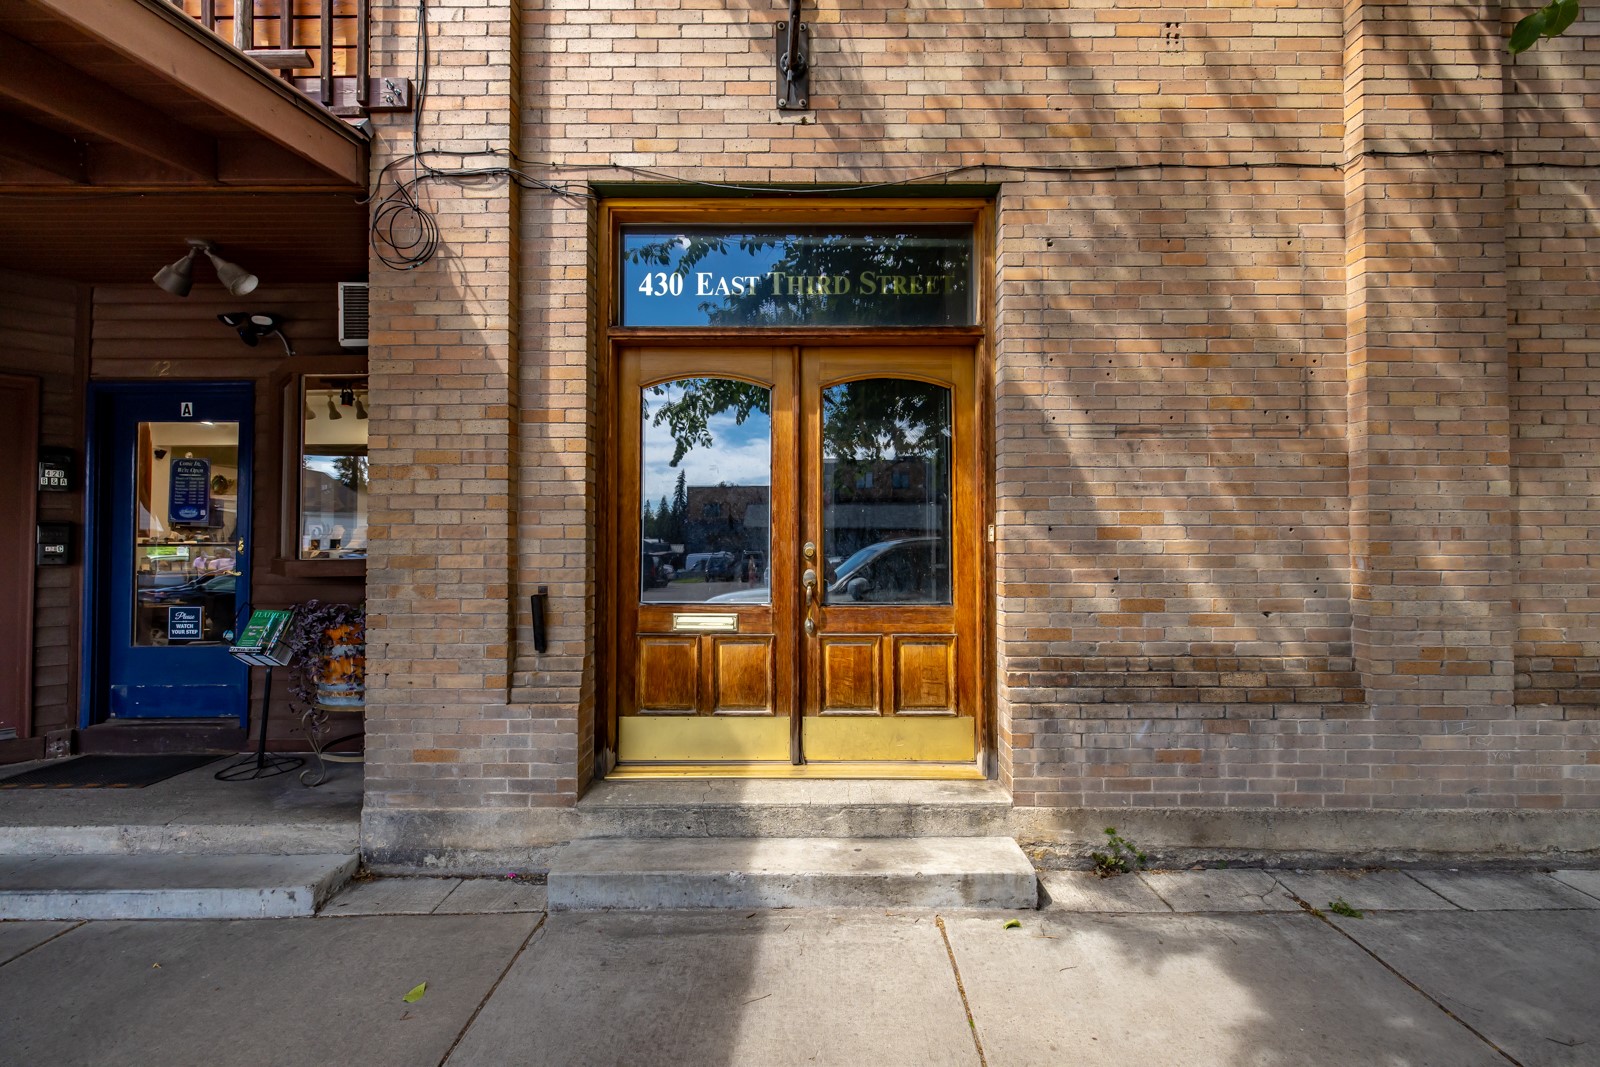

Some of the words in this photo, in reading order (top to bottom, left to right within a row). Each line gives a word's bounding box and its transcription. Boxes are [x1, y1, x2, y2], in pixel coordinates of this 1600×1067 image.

[638, 272, 683, 296] 430
[182, 403, 192, 416] A
[45, 469, 64, 478] 420
[175, 611, 195, 620] Please
